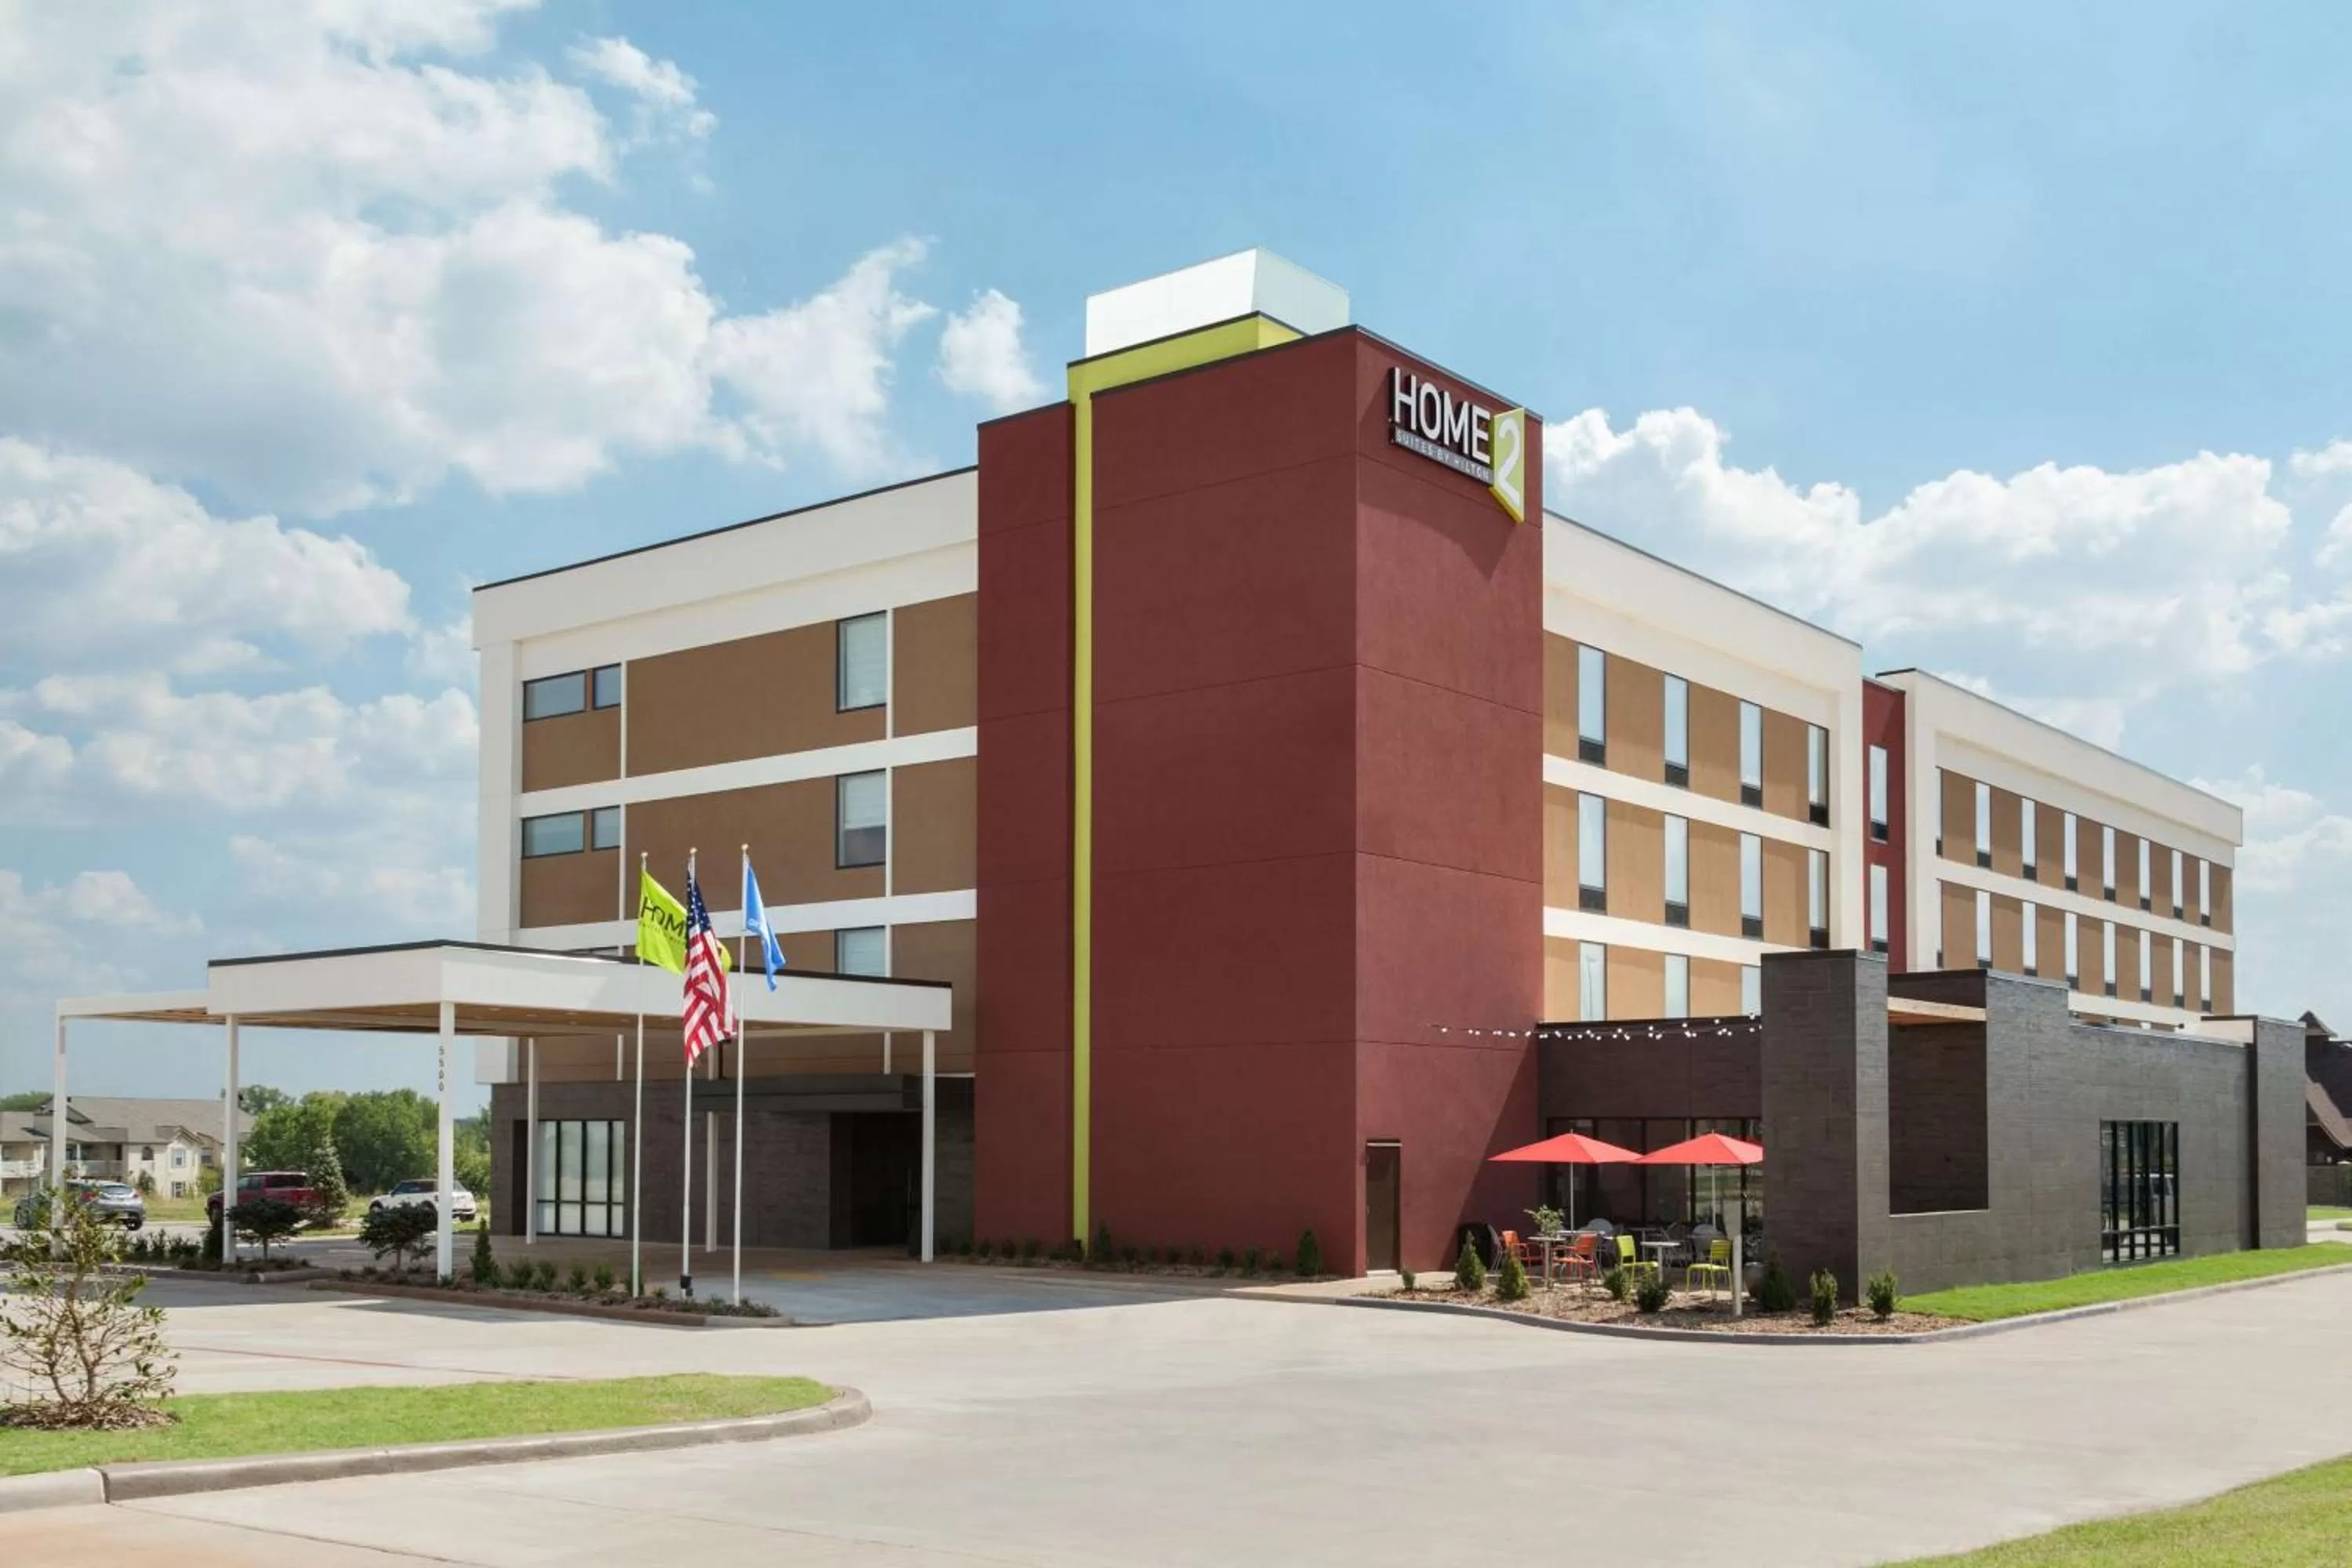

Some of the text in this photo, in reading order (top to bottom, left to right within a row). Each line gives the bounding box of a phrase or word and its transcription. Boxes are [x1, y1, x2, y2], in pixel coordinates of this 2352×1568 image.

[1394, 367, 1521, 509] HOME 2
[1396, 430, 1490, 481] SUITES BY HILTON
[641, 896, 685, 937] HOM
